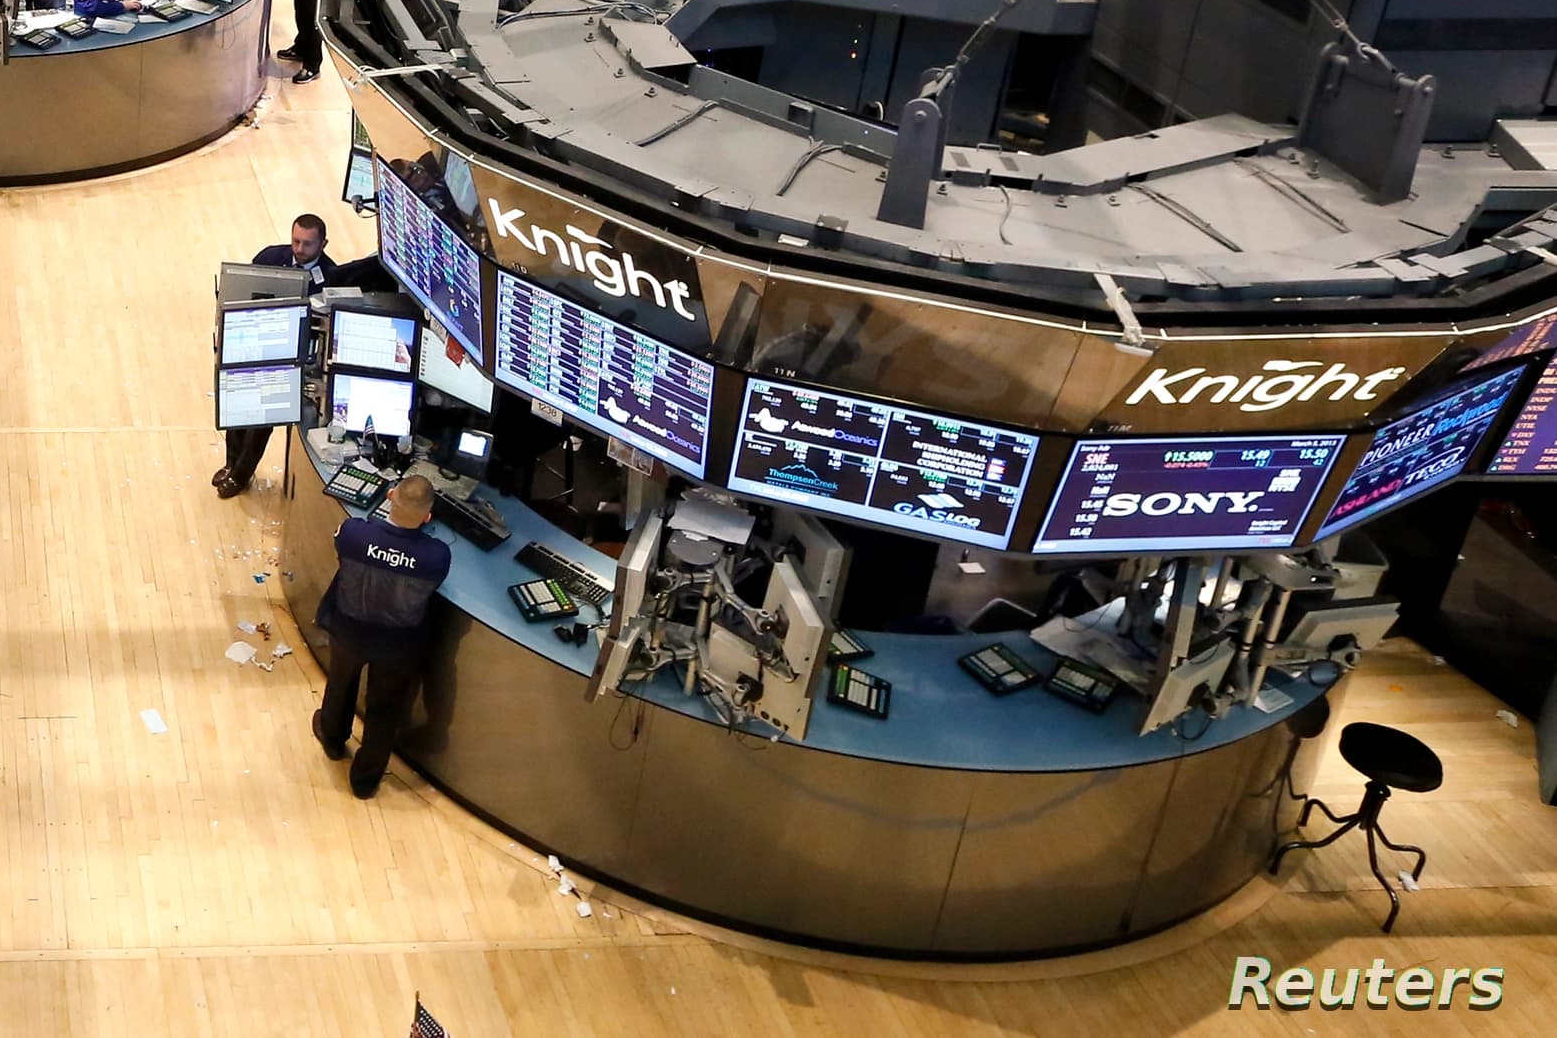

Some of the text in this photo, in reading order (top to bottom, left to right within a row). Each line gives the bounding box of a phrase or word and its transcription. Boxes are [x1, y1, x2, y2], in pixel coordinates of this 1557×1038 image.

[487, 197, 696, 322] Knight
[1124, 359, 1407, 413] Knight
[911, 439, 989, 464] INTERNATIONAL
[1240, 449, 1271, 461] 15.49
[1299, 448, 1329, 460] 15.50
[1361, 422, 1436, 468] PIONEER
[916, 458, 986, 480] CORPORATION
[1085, 453, 1110, 465] SNE
[366, 543, 417, 570] Knight
